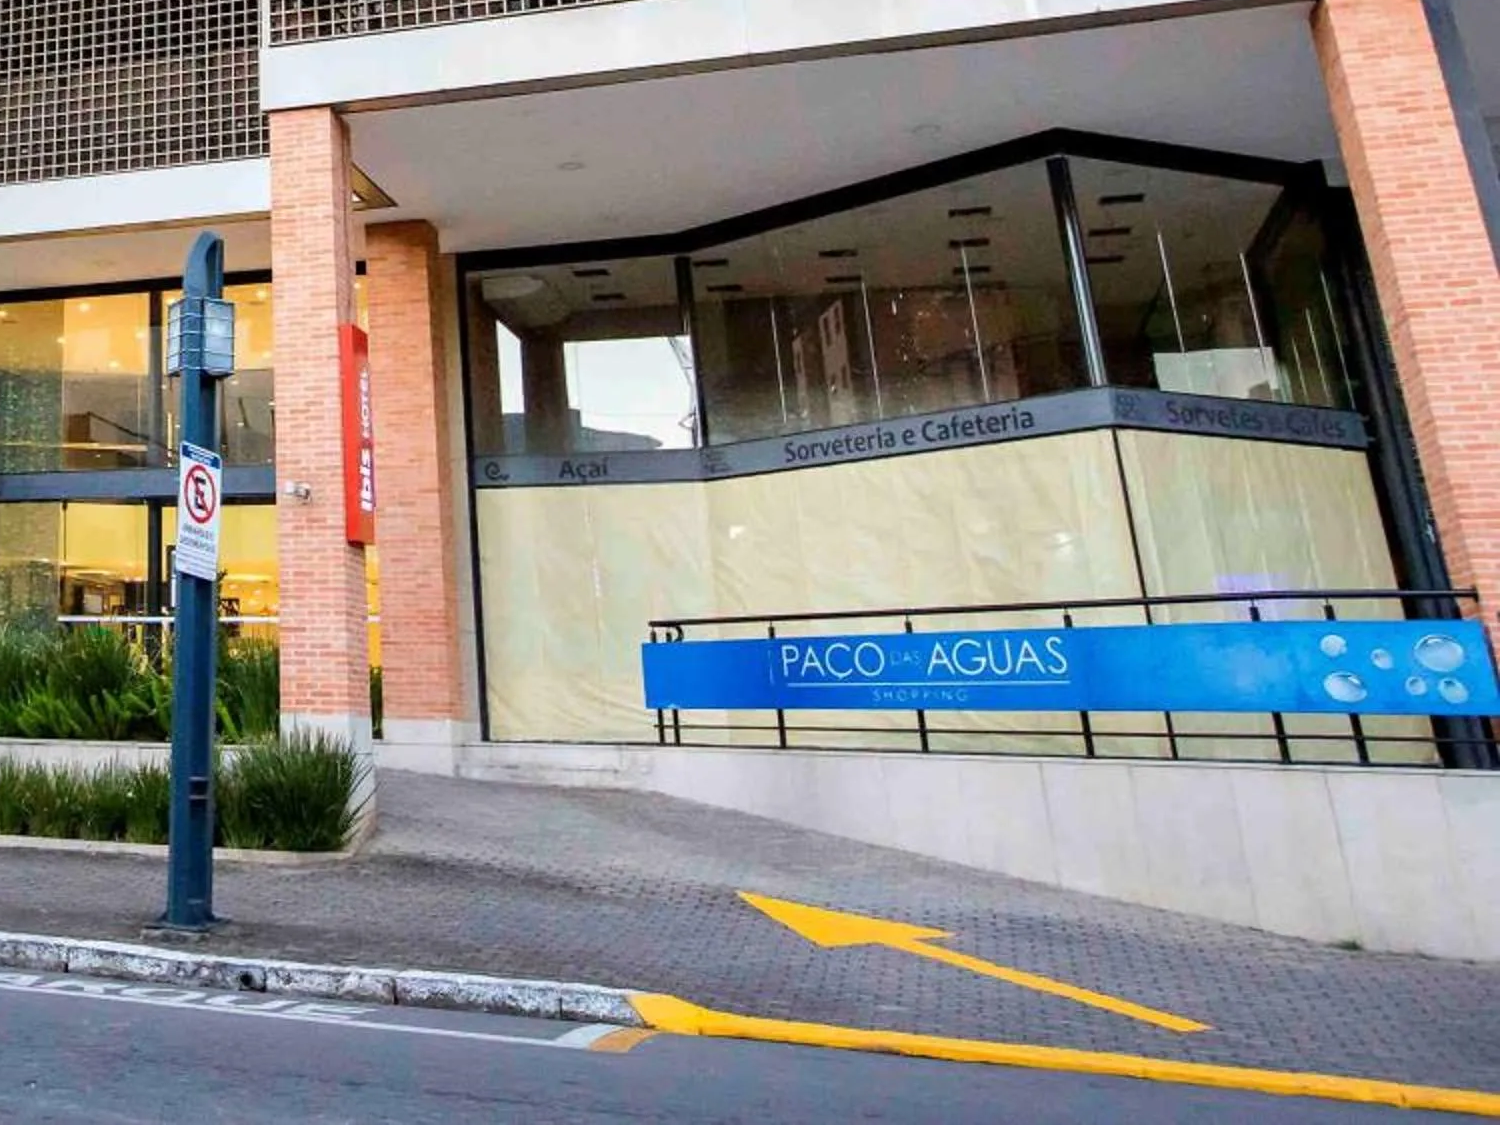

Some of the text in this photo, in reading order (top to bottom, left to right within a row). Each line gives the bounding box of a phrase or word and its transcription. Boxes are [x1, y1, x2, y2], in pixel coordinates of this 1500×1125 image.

[784, 407, 1035, 463] Sorveteria e Cafeteria
[1165, 400, 1264, 431] Sorvetes
[359, 447, 373, 512] ibis
[872, 687, 969, 703] SHOPPING
